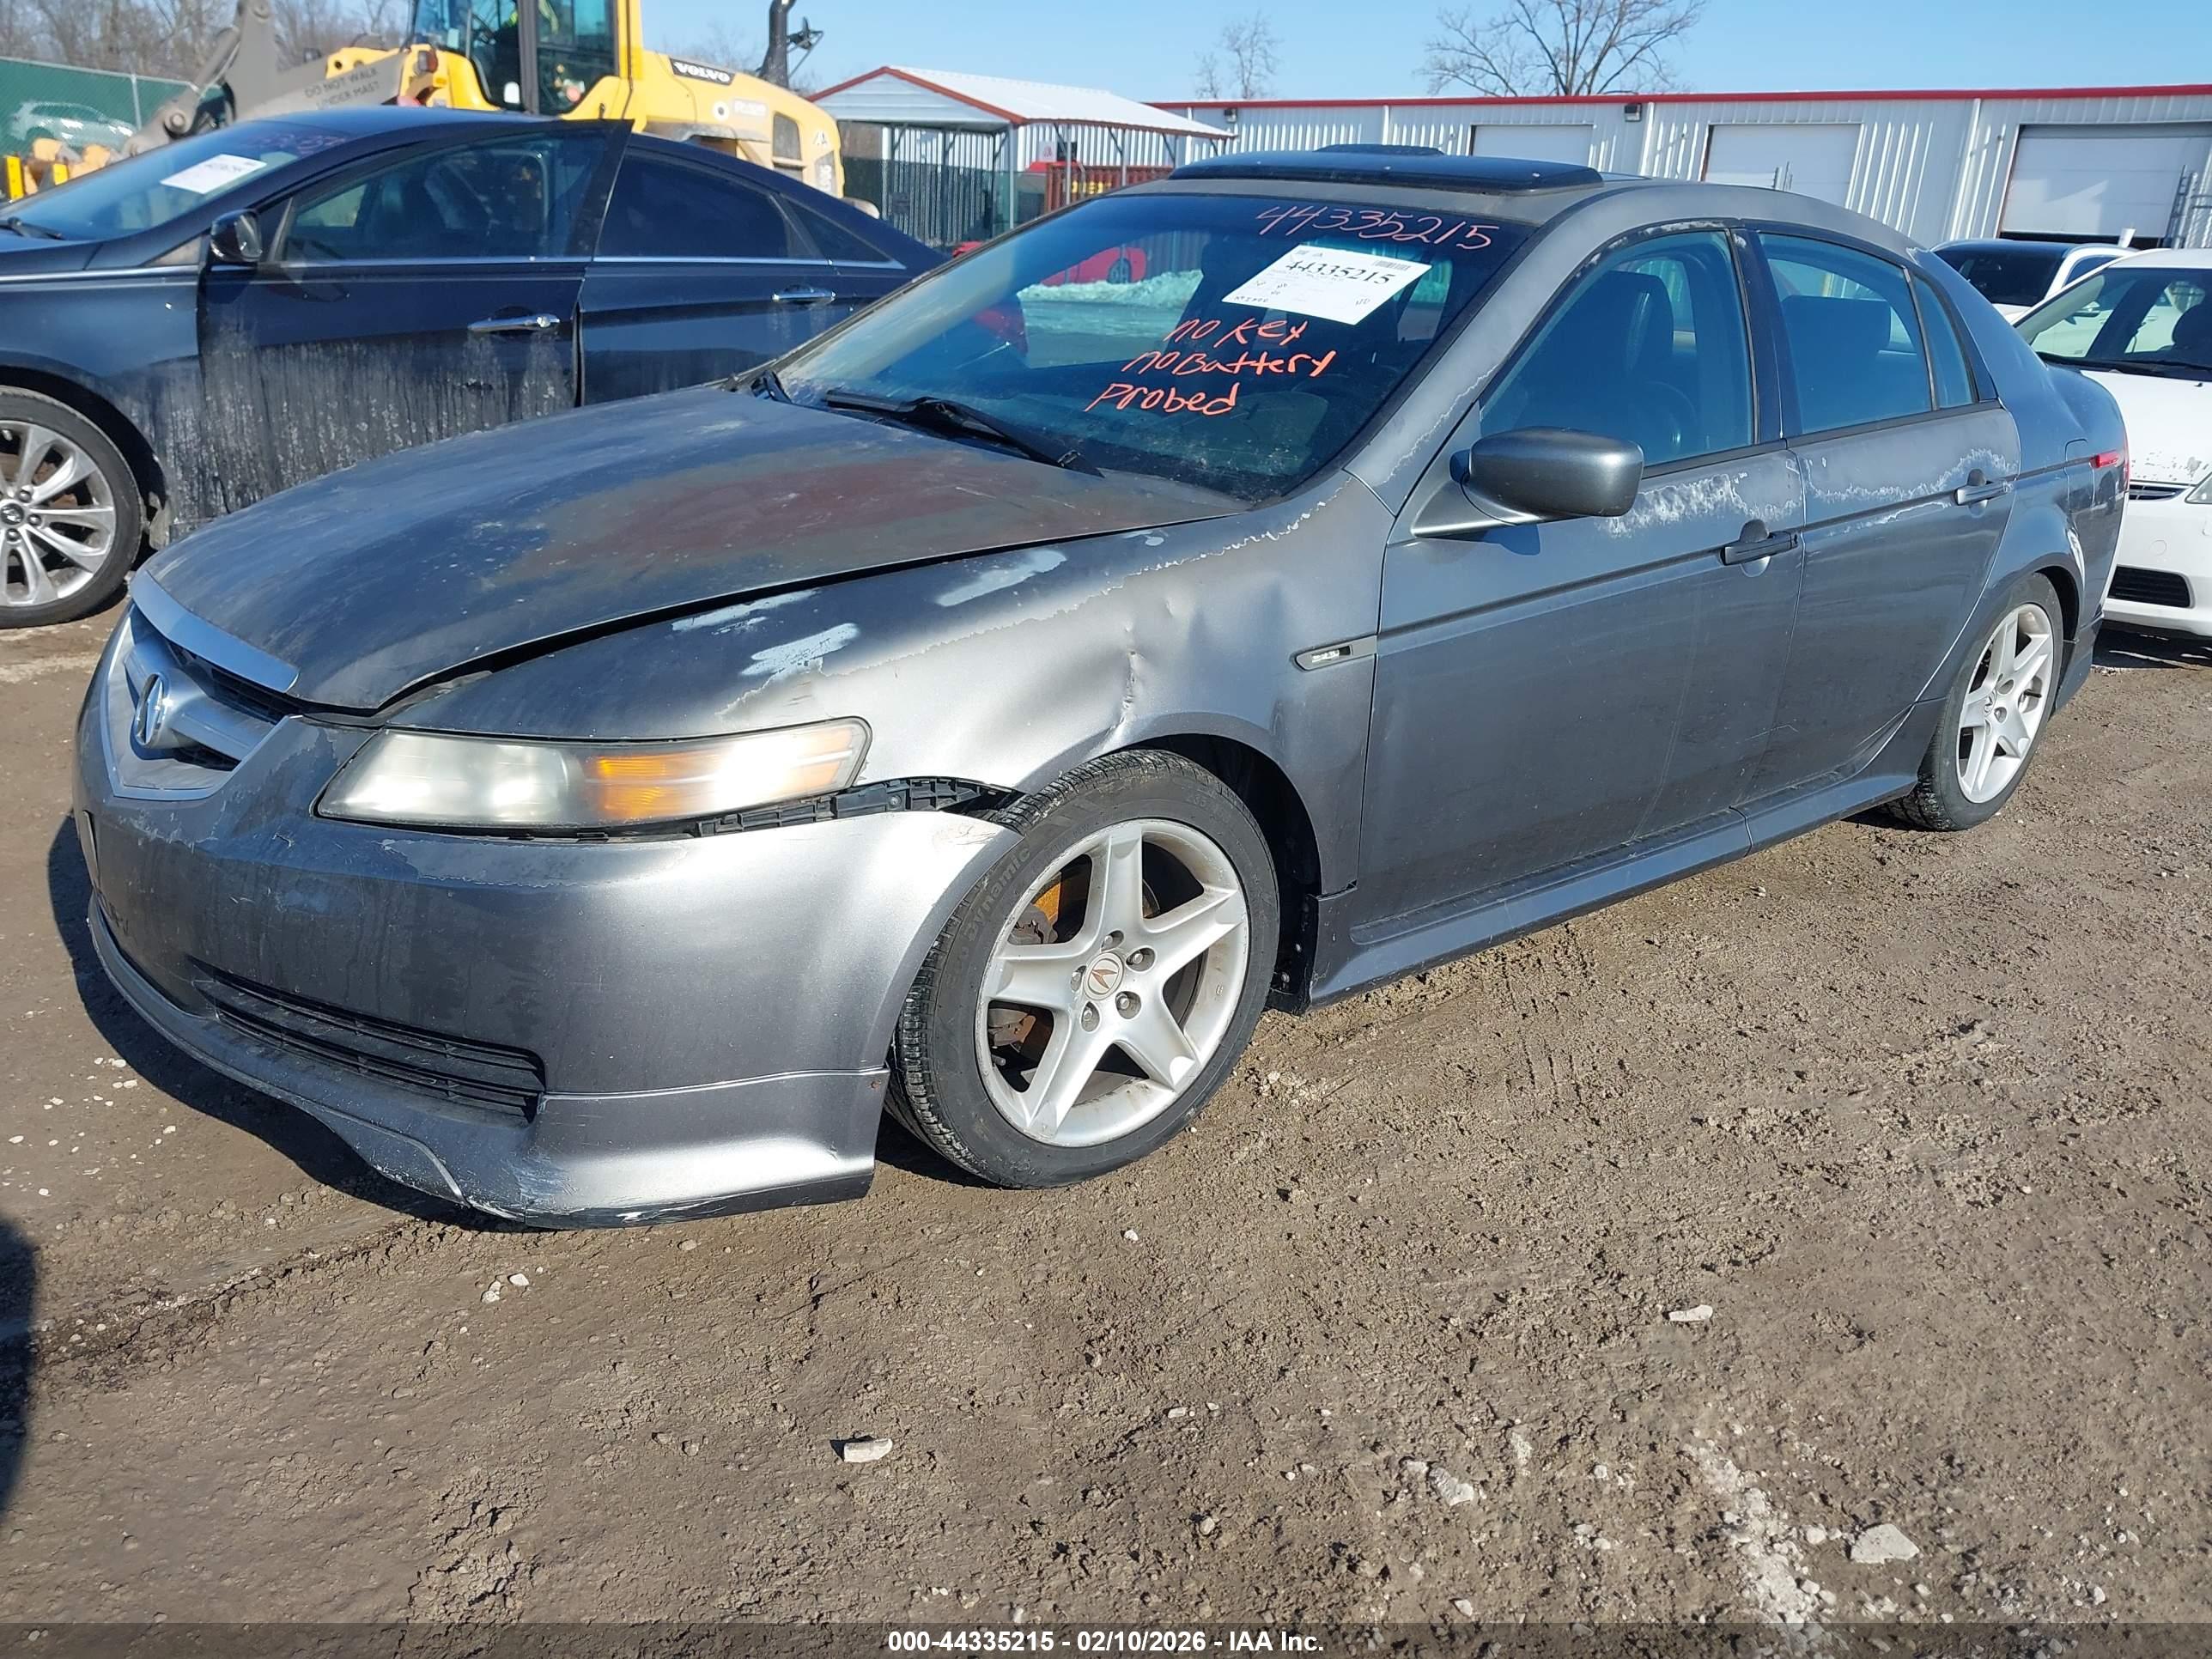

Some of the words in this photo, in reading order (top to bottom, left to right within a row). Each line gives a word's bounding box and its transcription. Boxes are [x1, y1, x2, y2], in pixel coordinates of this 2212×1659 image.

[305, 84, 322, 99] DO
[322, 77, 345, 92] NOT
[349, 67, 378, 82] WALK
[673, 60, 731, 82] VOLVO
[353, 81, 380, 98] MAST
[1255, 204, 1500, 251] 44335215
[1285, 259, 1397, 285] 44335215
